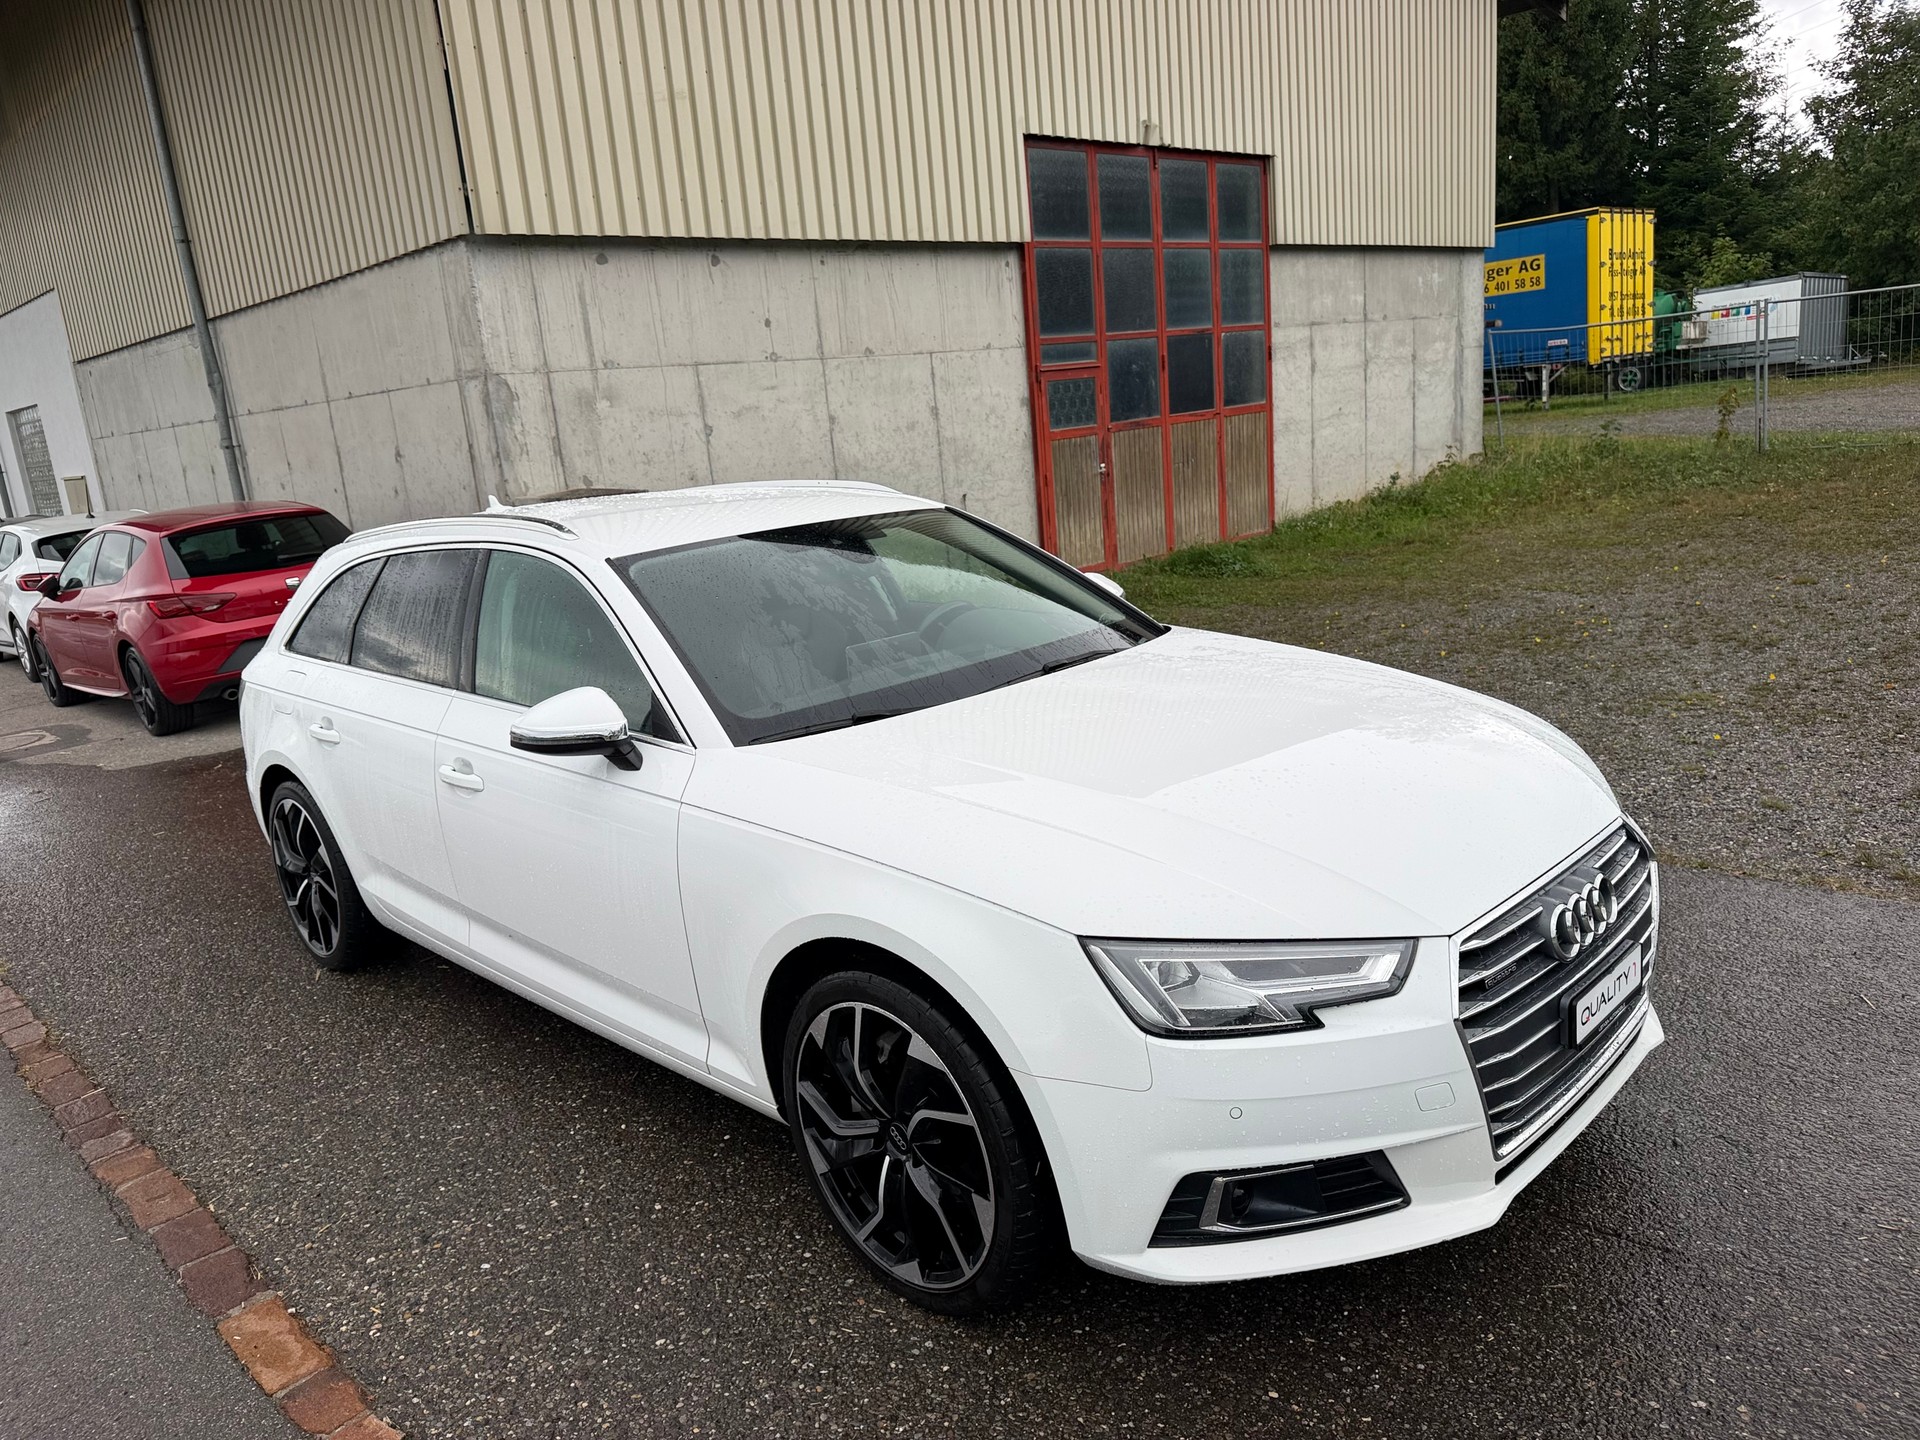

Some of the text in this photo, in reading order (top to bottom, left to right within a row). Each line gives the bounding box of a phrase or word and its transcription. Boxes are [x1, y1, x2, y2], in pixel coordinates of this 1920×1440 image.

[1484, 258, 1541, 282] ger AG
[1494, 280, 1510, 292] 401
[1515, 278, 1526, 290] 58
[1530, 276, 1541, 287] 58
[1581, 966, 1631, 1026] QUALITY
[1632, 961, 1638, 977] 1
